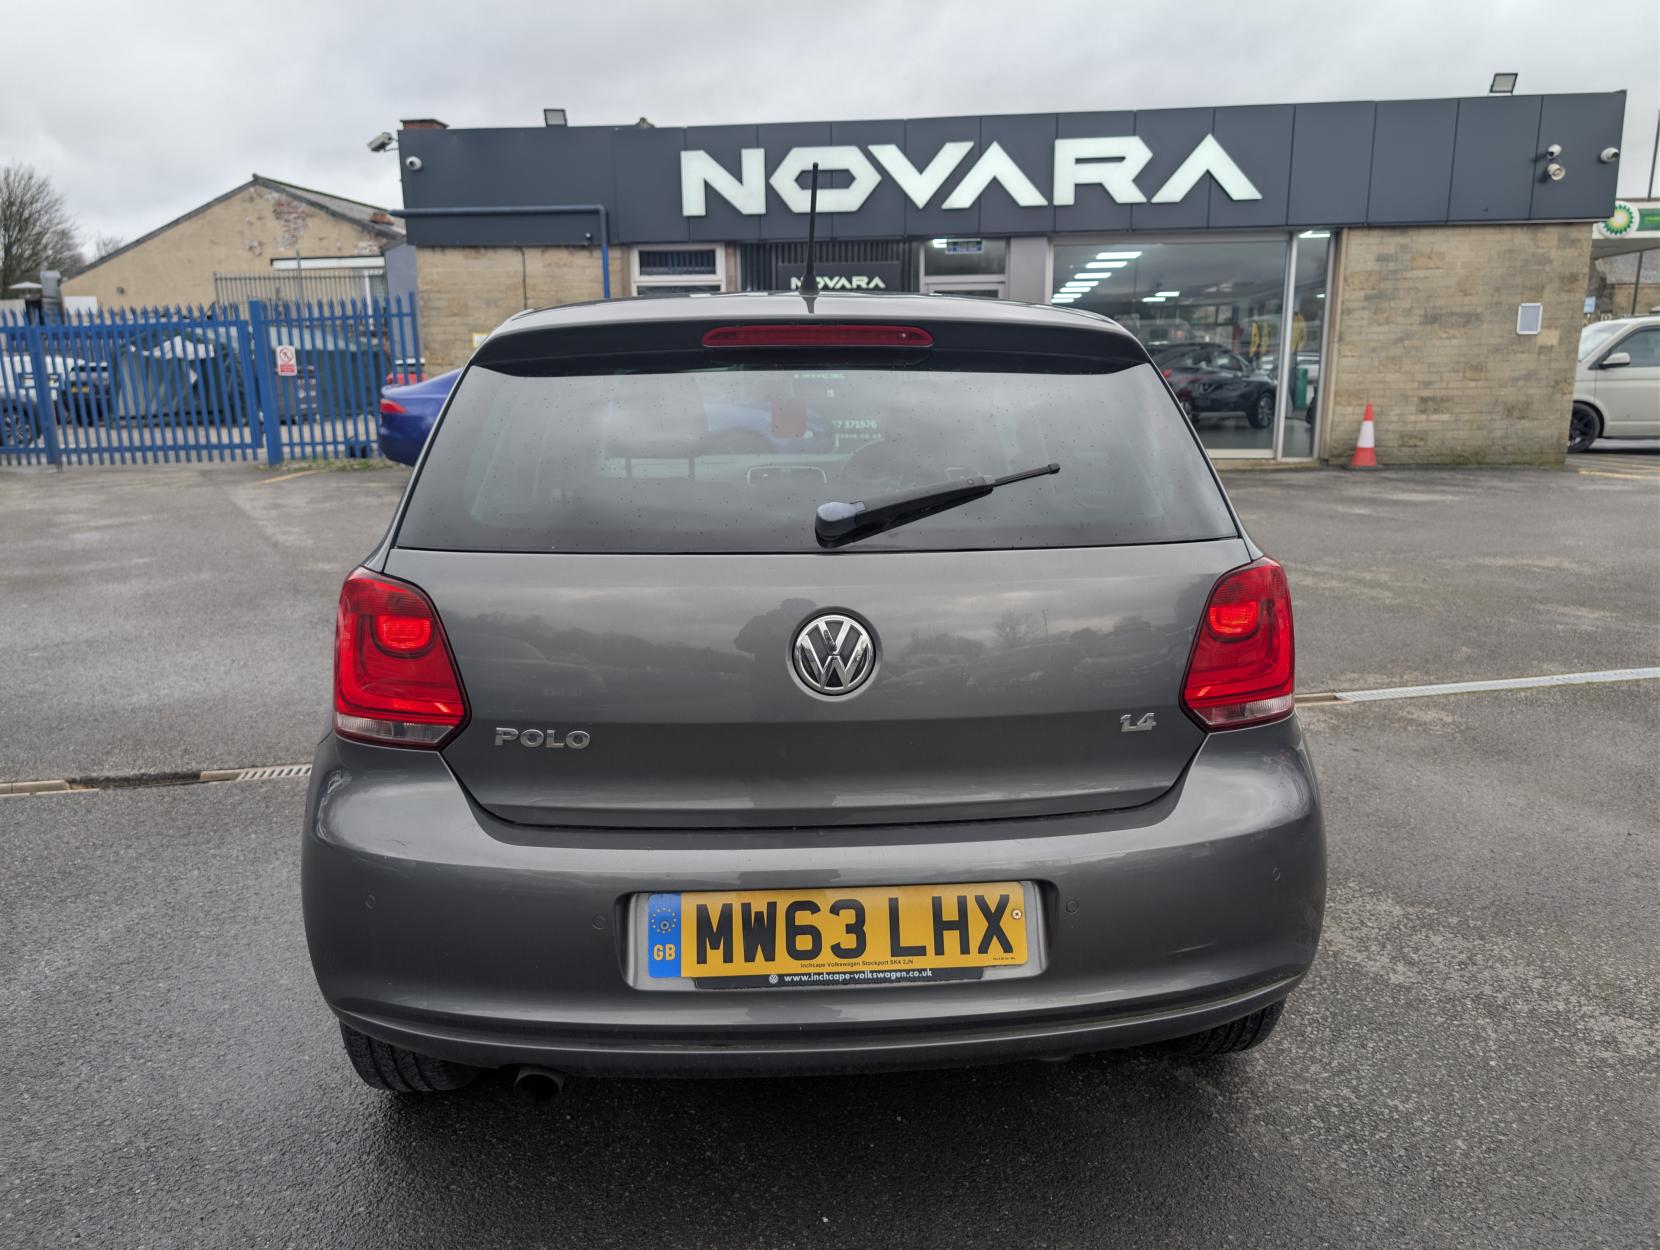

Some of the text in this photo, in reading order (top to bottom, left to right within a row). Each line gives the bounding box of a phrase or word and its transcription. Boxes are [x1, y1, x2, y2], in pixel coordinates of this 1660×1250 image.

[680, 133, 1263, 217] NOVARA
[495, 727, 591, 749] POLO
[696, 894, 1014, 965] MW63 LHX
[653, 943, 676, 961] GB
[800, 961, 826, 969] Inchcape
[827, 960, 861, 968] Volkswagen
[784, 968, 932, 982] www.inchcape-volkswagen.co.uk
